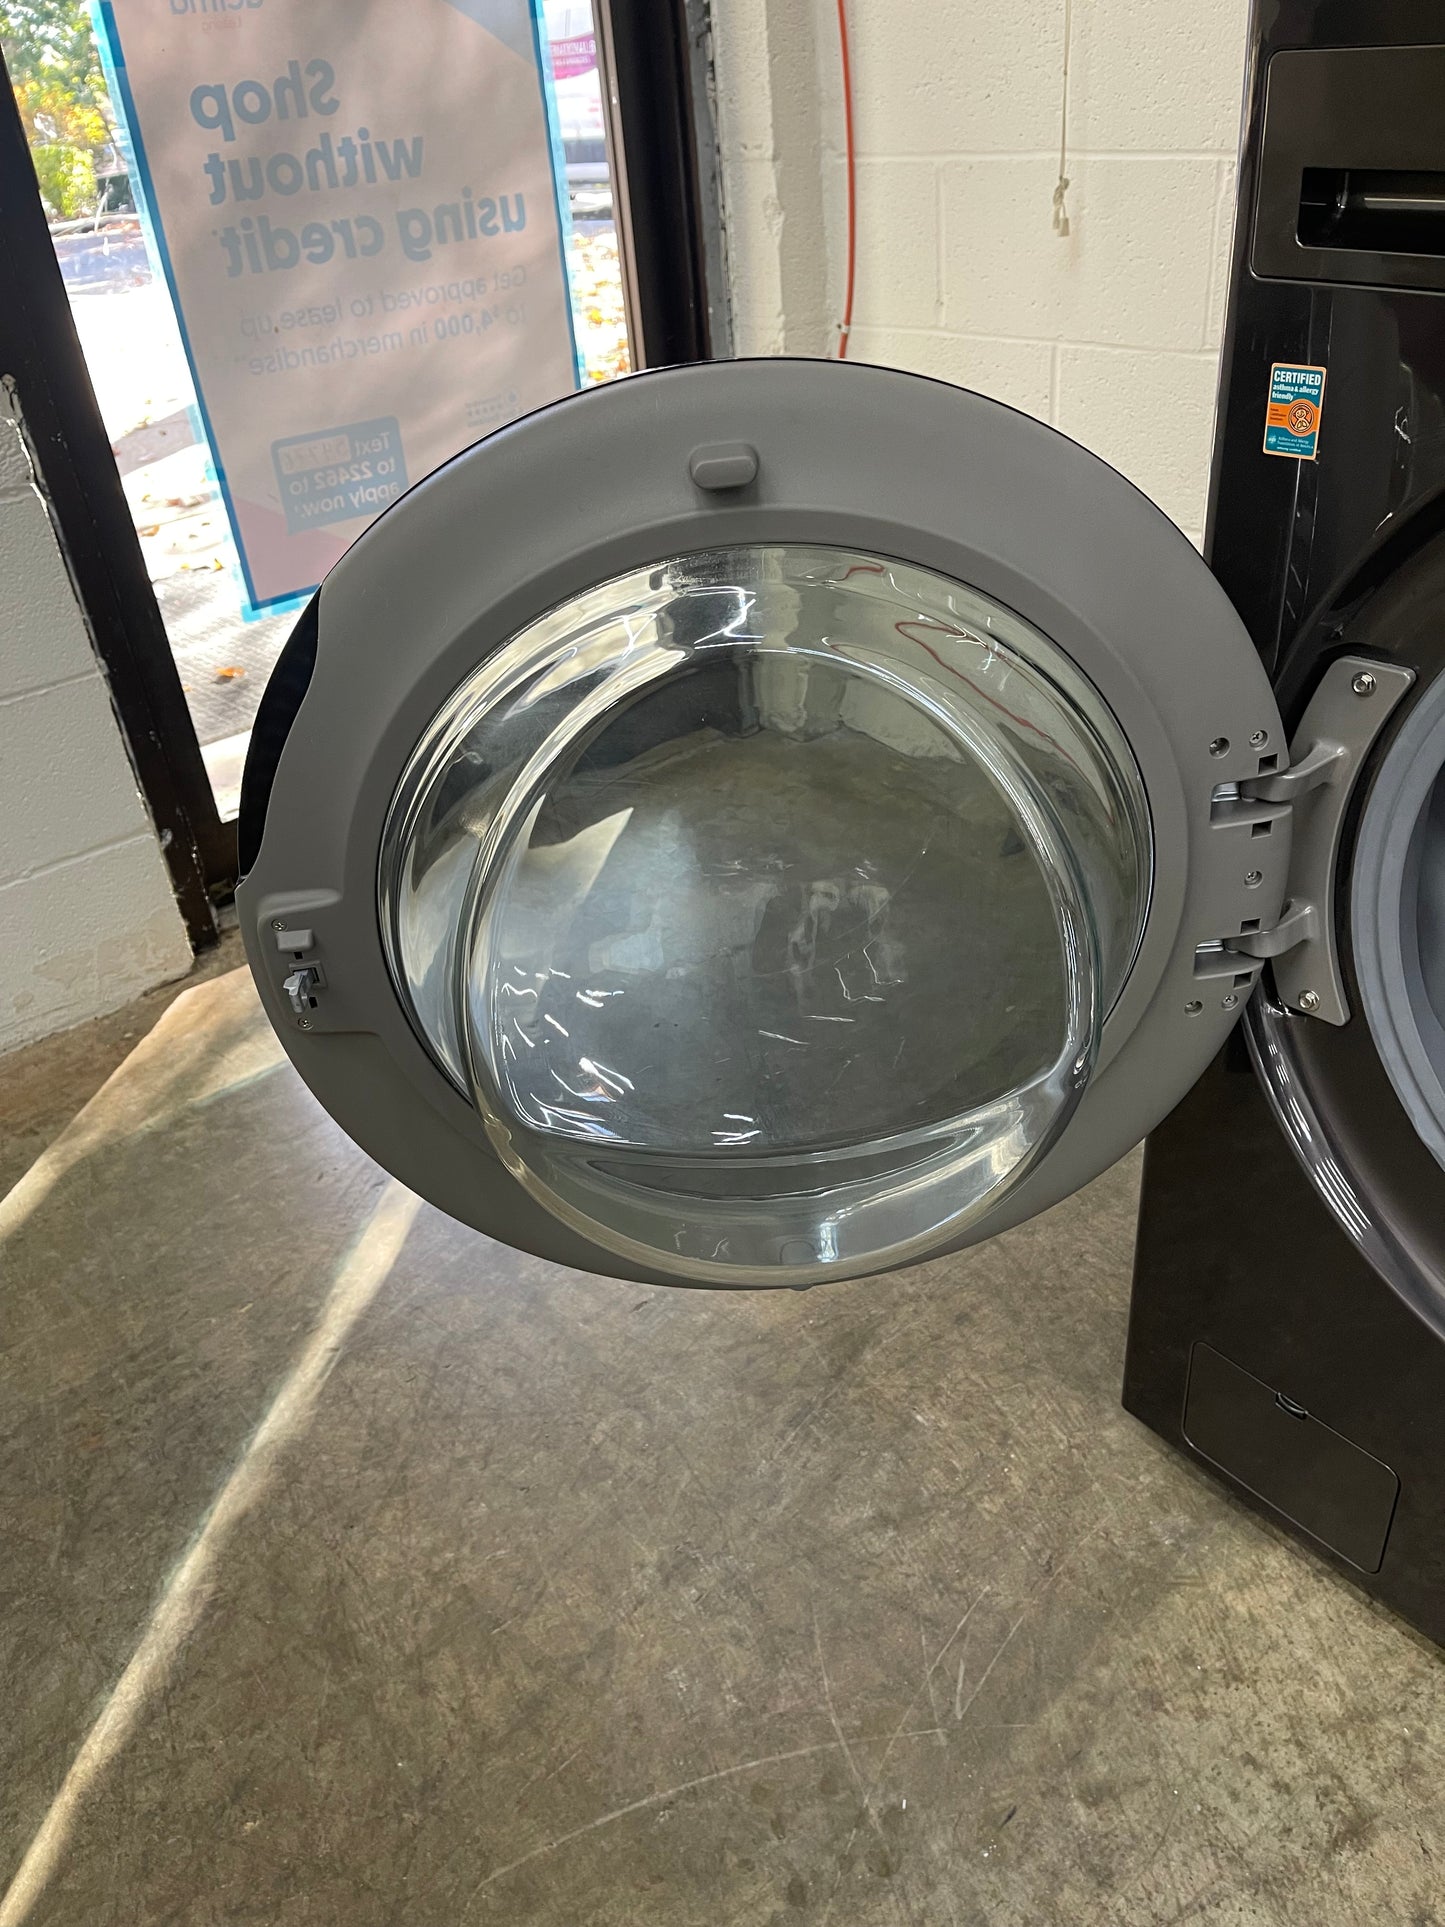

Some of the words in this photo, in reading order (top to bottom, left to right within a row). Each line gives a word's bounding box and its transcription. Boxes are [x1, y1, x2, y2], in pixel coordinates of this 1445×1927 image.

[1273, 370, 1322, 386] CERTIFIED
[1272, 384, 1294, 392] asthma
[1299, 386, 1319, 396] allergy
